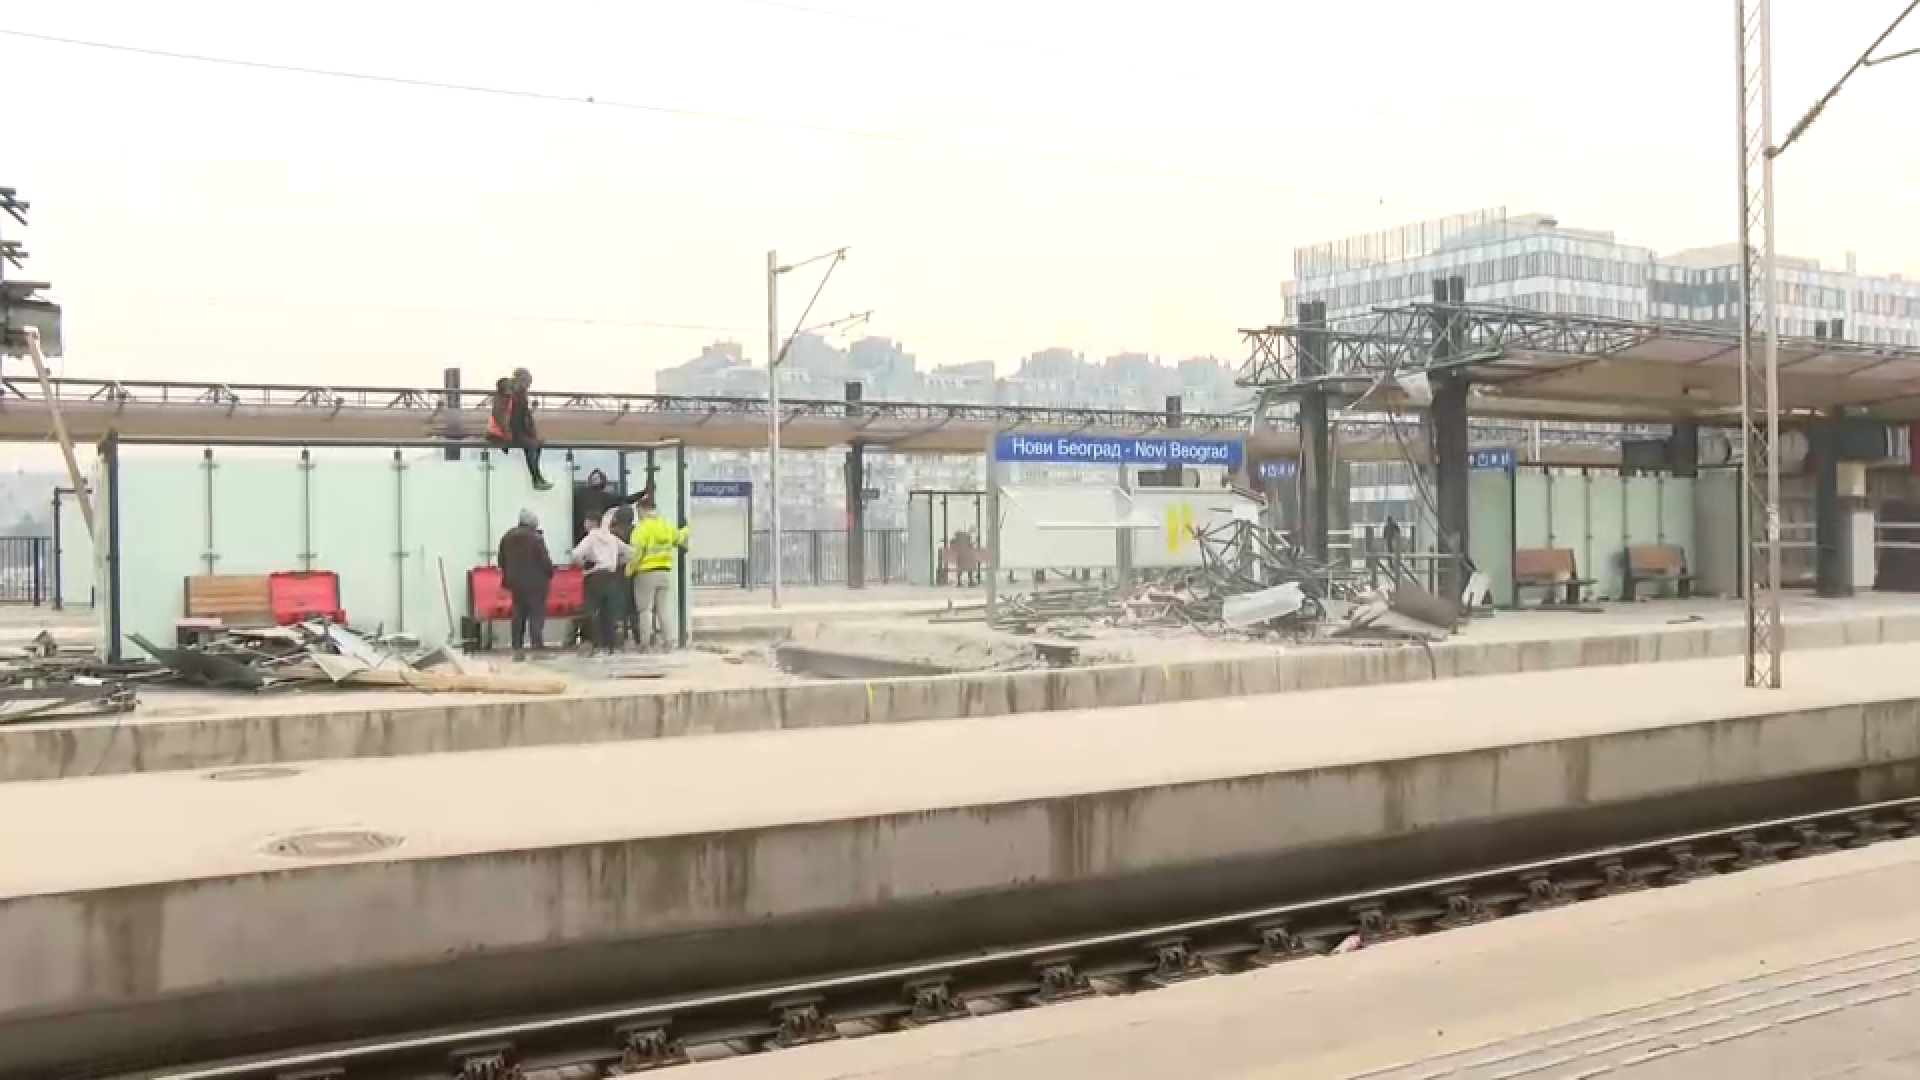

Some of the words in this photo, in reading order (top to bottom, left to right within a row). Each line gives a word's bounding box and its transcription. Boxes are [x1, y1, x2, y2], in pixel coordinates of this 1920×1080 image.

[1013, 438, 1053, 456] Нови
[1057, 439, 1121, 460] Београд
[1135, 440, 1167, 457] Novi
[1170, 441, 1229, 462] Beograd
